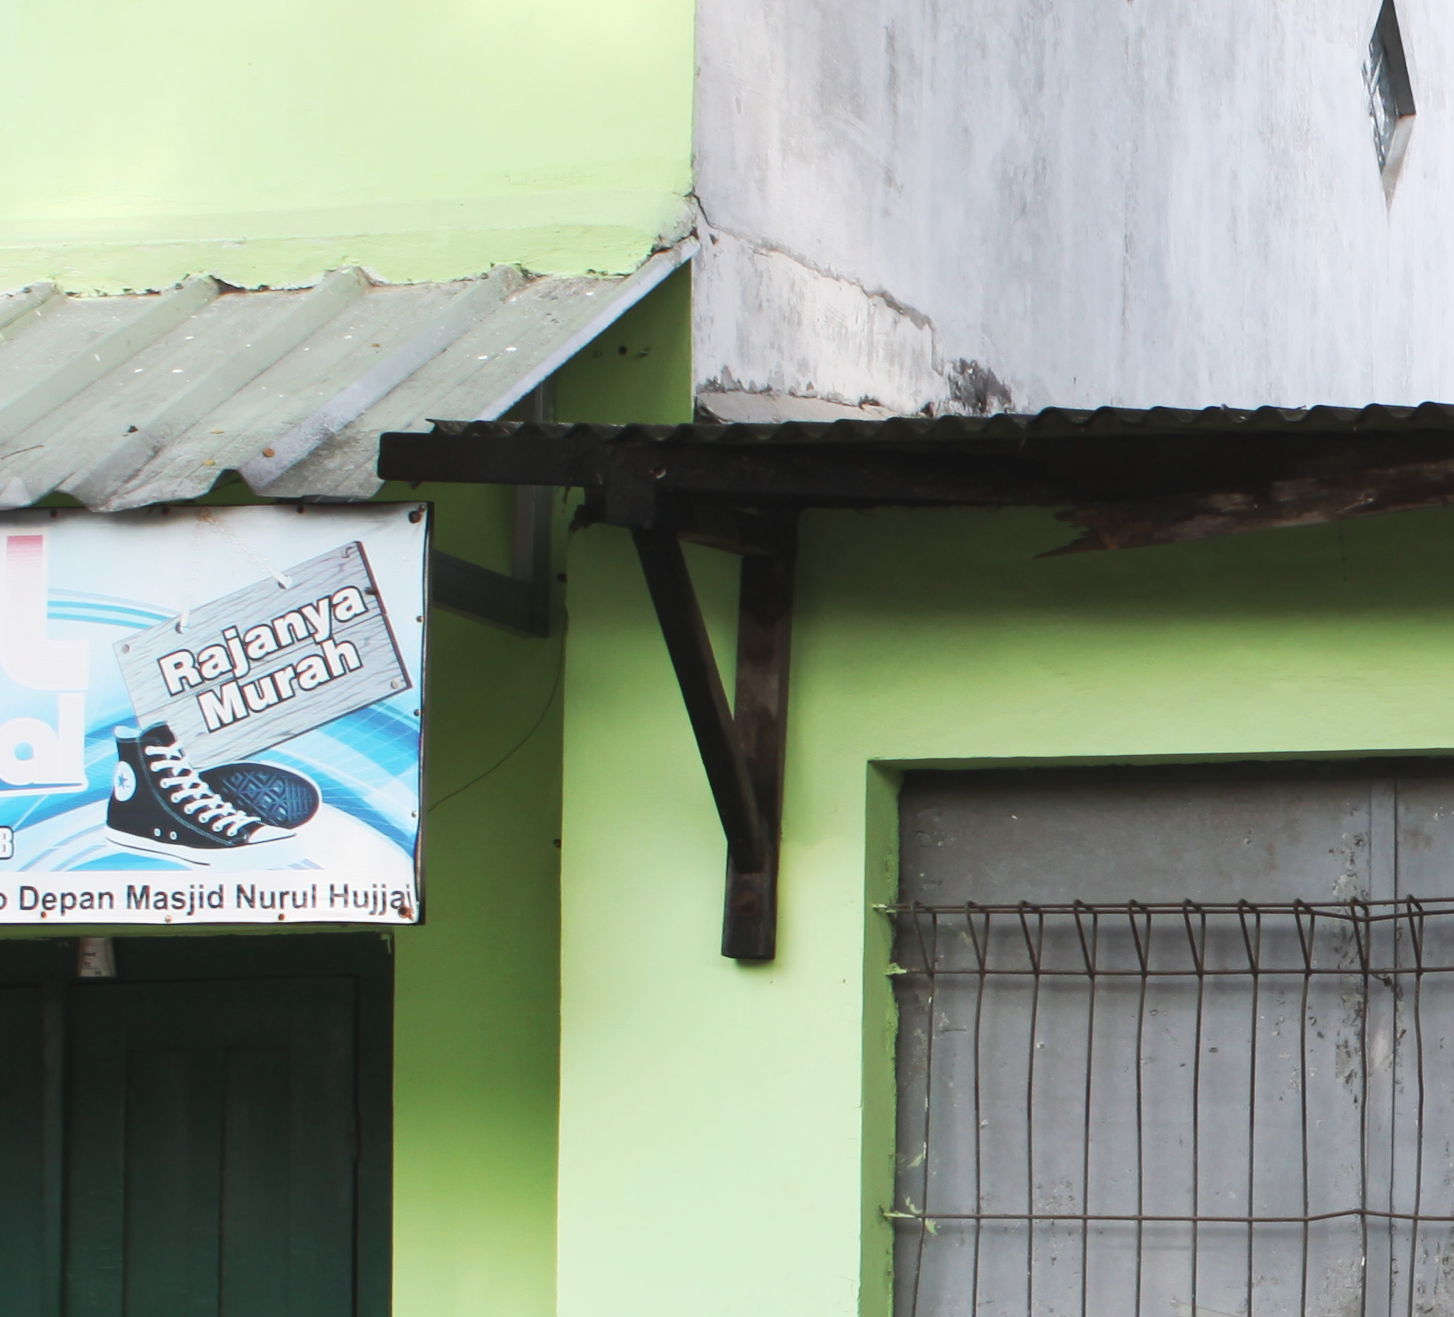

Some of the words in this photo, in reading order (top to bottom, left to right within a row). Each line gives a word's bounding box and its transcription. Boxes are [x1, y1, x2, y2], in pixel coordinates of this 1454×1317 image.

[157, 585, 369, 697] Rajanya
[196, 637, 364, 734] Murah
[19, 885, 114, 916] Depan
[126, 884, 224, 916] Masjid
[236, 883, 317, 910] Nurul
